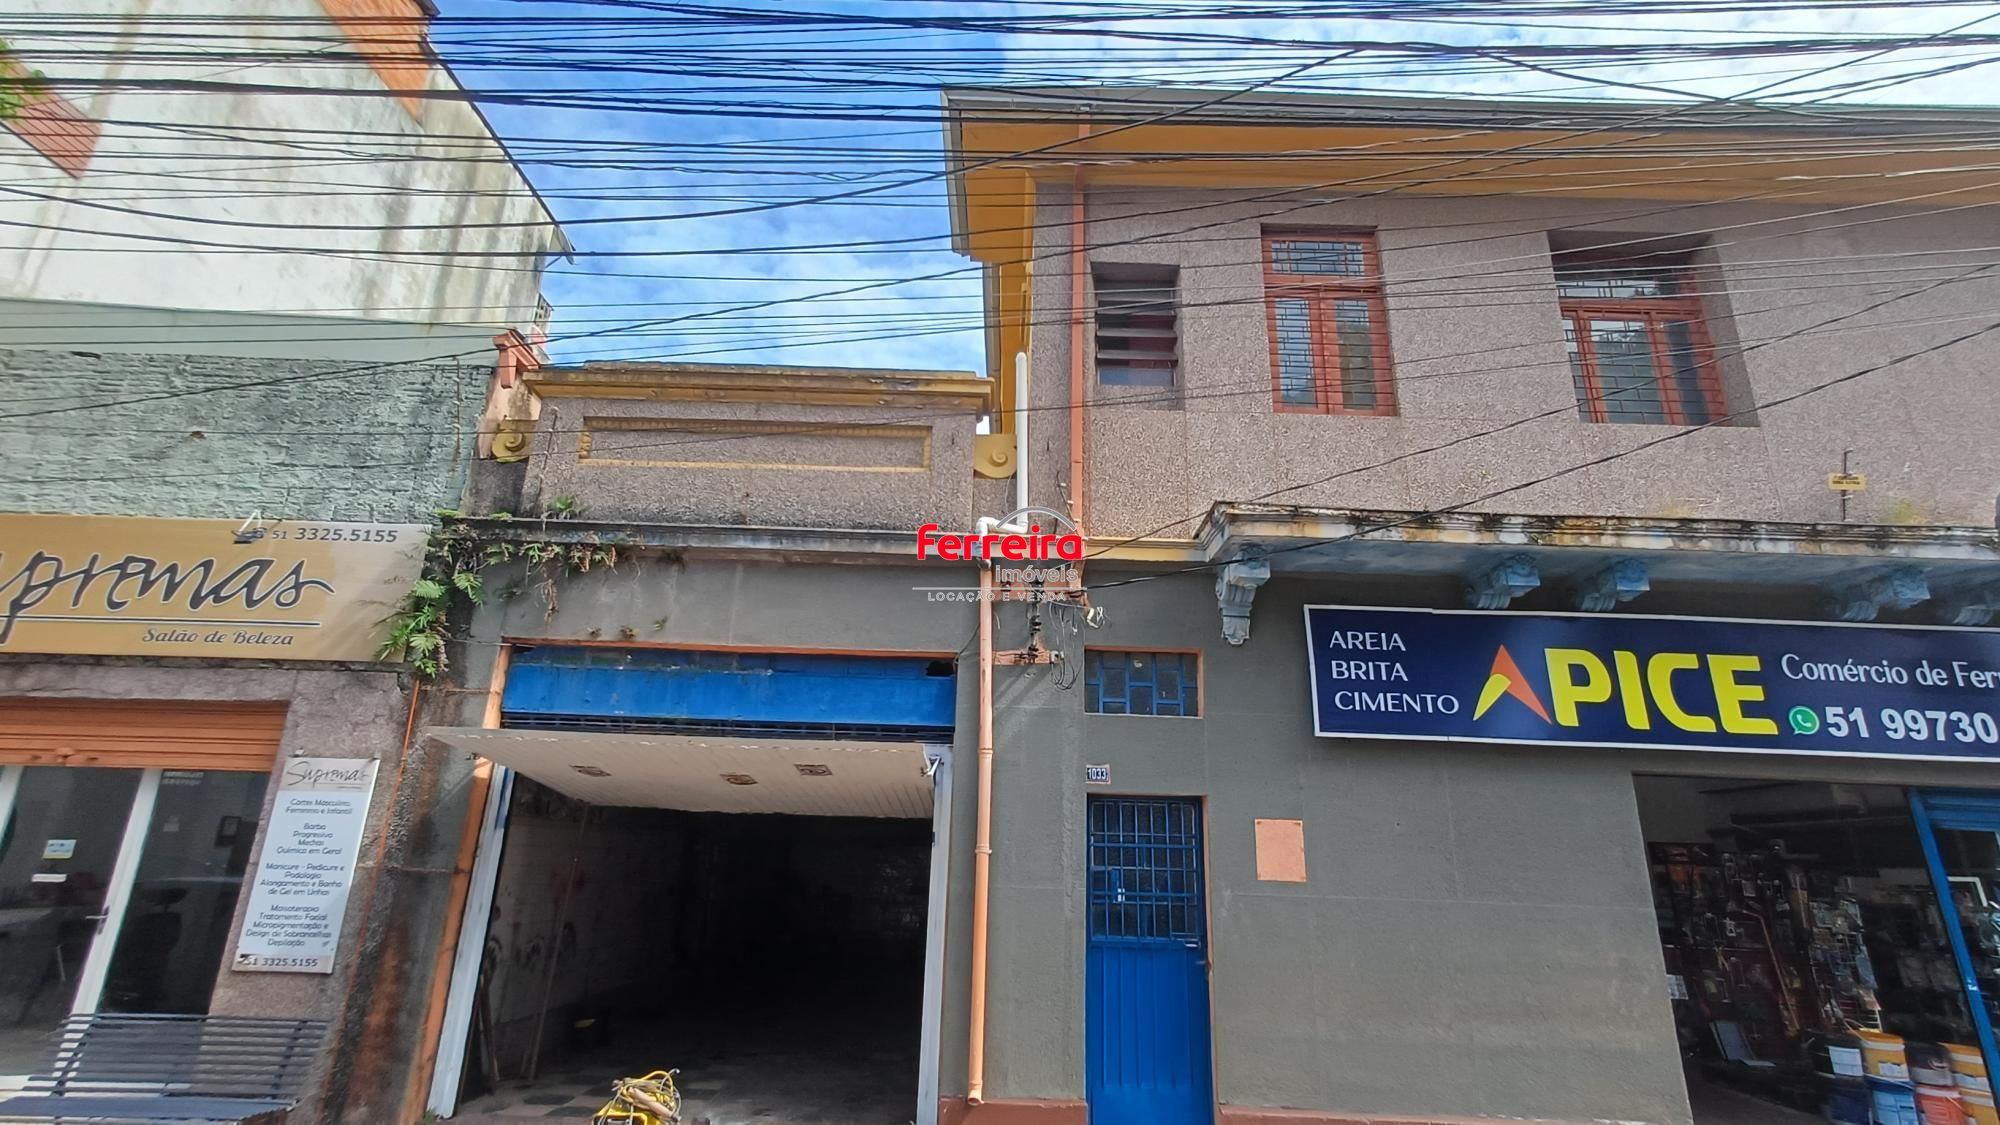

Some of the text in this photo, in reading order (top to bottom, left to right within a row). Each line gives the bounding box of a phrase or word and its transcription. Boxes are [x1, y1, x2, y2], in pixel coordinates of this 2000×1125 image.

[272, 528, 398, 542] 51 3325.5155
[142, 628, 294, 645] Salão de Beleza
[1329, 630, 1406, 651] AREIA
[1331, 660, 1408, 681] BRITA
[1781, 653, 2000, 688] Comércio de Fer
[1334, 691, 1460, 714] CIMENTO
[1825, 706, 1999, 743] 51 99730
[1088, 768, 1106, 780] 1033
[306, 863, 338, 871] Pedicure
[304, 913, 328, 921] Facial
[261, 958, 319, 967] 3325.5155
